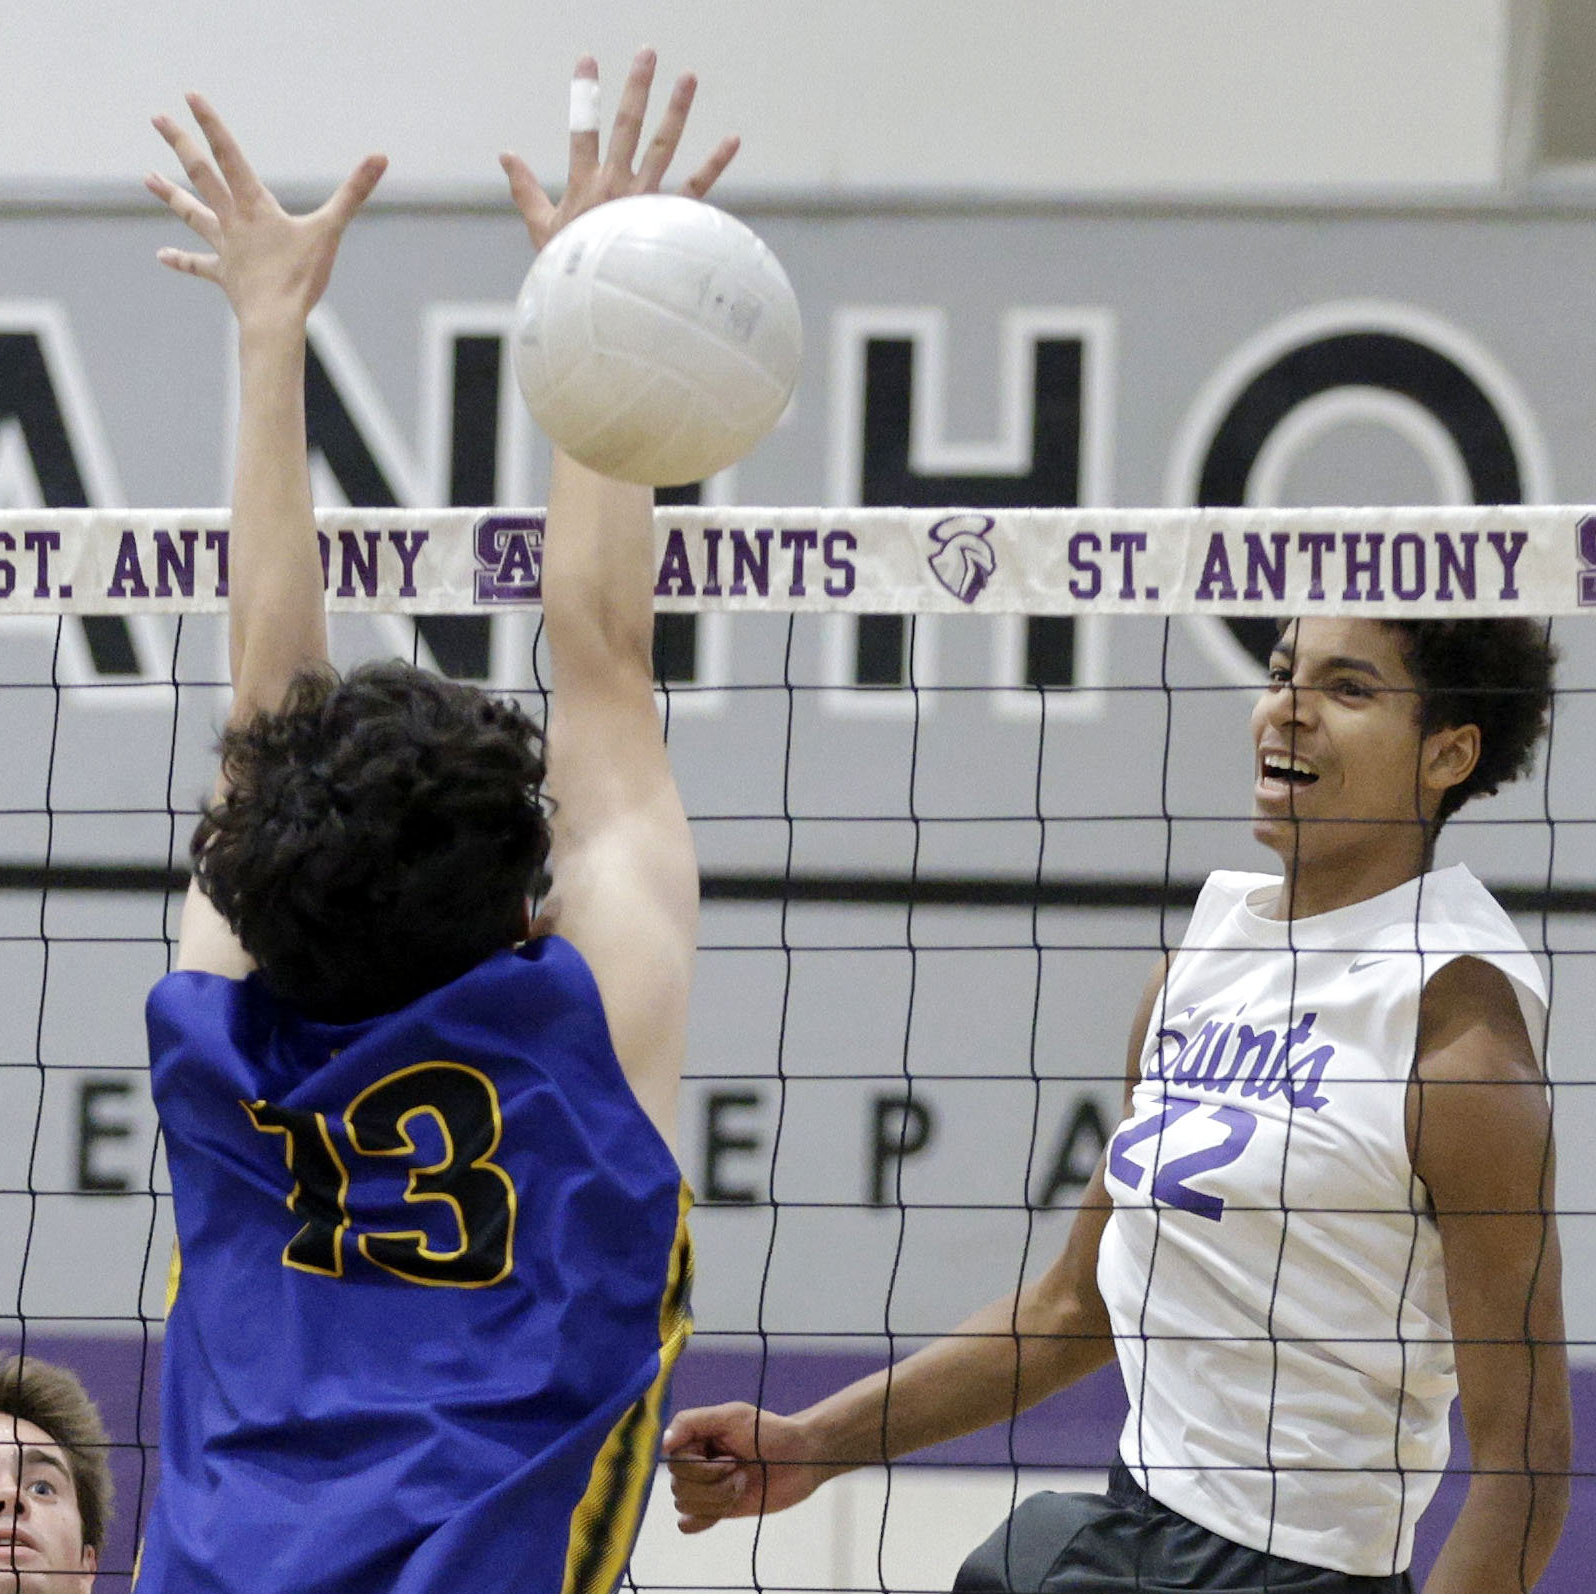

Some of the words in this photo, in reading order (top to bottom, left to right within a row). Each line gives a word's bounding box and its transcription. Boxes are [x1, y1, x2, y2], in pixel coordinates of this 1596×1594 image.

[107, 530, 429, 598] ANTNY
[653, 528, 858, 599] AINTS
[1067, 531, 1159, 600] ST.
[1194, 531, 1529, 601] ANTHONY
[238, 1060, 518, 1289] 13
[1108, 1096, 1257, 1223] 22
